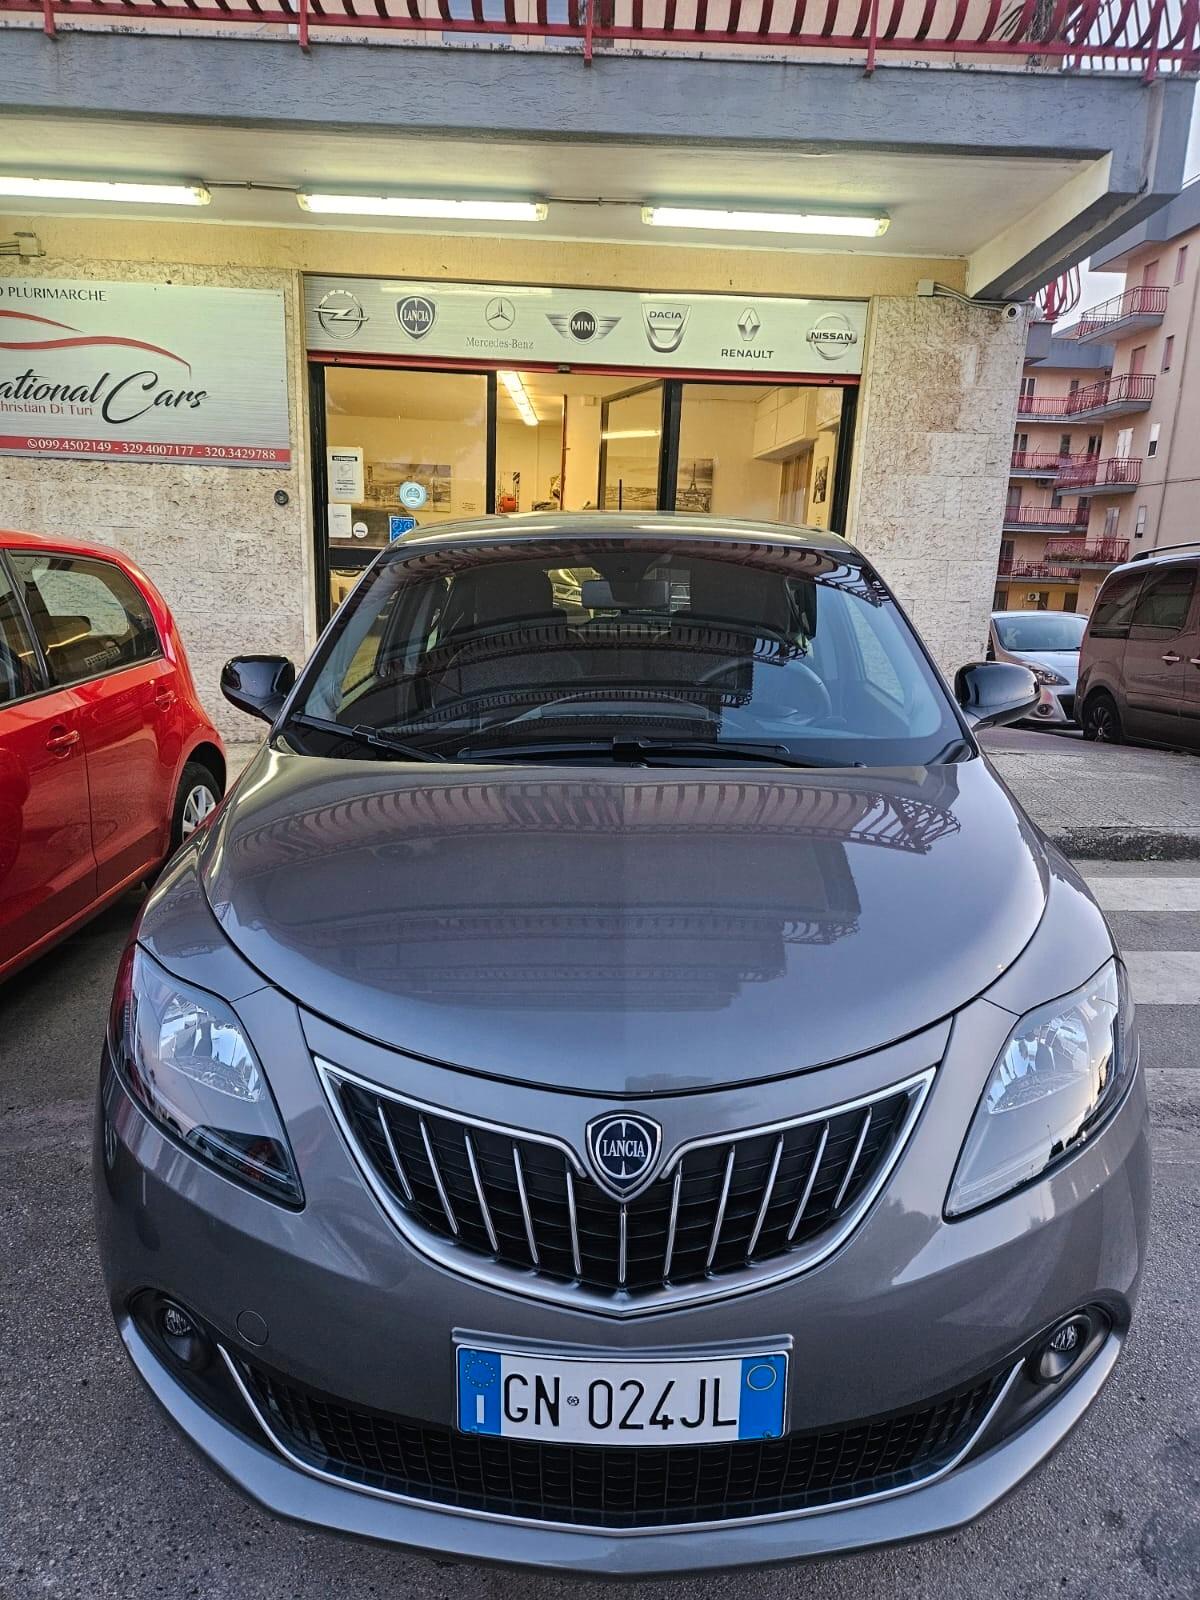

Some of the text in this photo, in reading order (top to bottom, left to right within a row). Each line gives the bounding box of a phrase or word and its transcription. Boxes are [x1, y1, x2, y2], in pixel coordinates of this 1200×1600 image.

[8, 286, 107, 302] PLURIMARCHE
[403, 309, 430, 322] LANCIA
[649, 310, 682, 320] DACIA
[571, 320, 595, 332] MINI
[466, 336, 534, 350] Mercedes-Benz
[810, 331, 853, 342] NISSAN
[720, 348, 774, 359] RENAULT
[101, 370, 210, 424] Cars
[50, 403, 64, 415] Di
[68, 404, 93, 416] Turi
[38, 439, 111, 452] 099.4502149
[122, 443, 194, 456] 329.4007177
[205, 447, 276, 459] 320.3429788
[603, 1140, 646, 1157] LANCIA
[503, 1373, 738, 1430] GN 024JL
